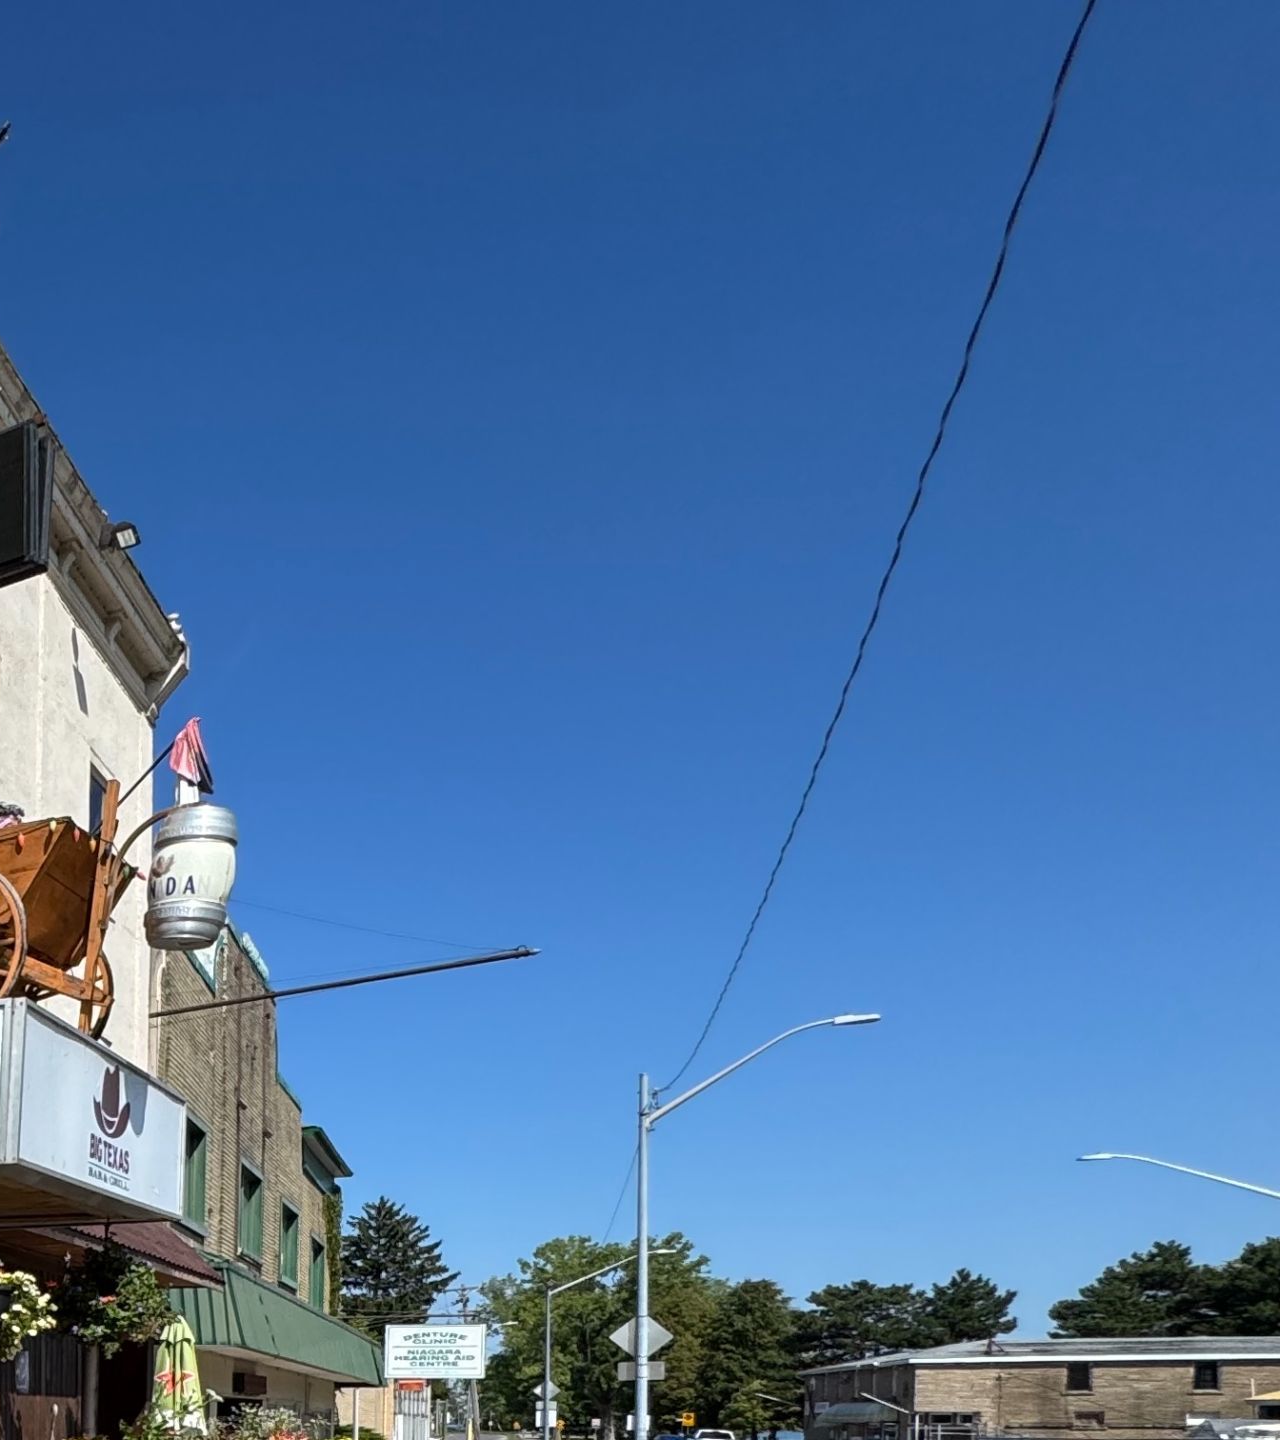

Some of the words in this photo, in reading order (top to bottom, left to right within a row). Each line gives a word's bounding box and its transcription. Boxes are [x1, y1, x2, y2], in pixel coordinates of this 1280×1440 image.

[89, 1133, 102, 1162] BIG
[103, 1140, 129, 1174] TEXAS
[88, 1167, 103, 1180] BAR
[403, 1332, 468, 1341] DENTURE
